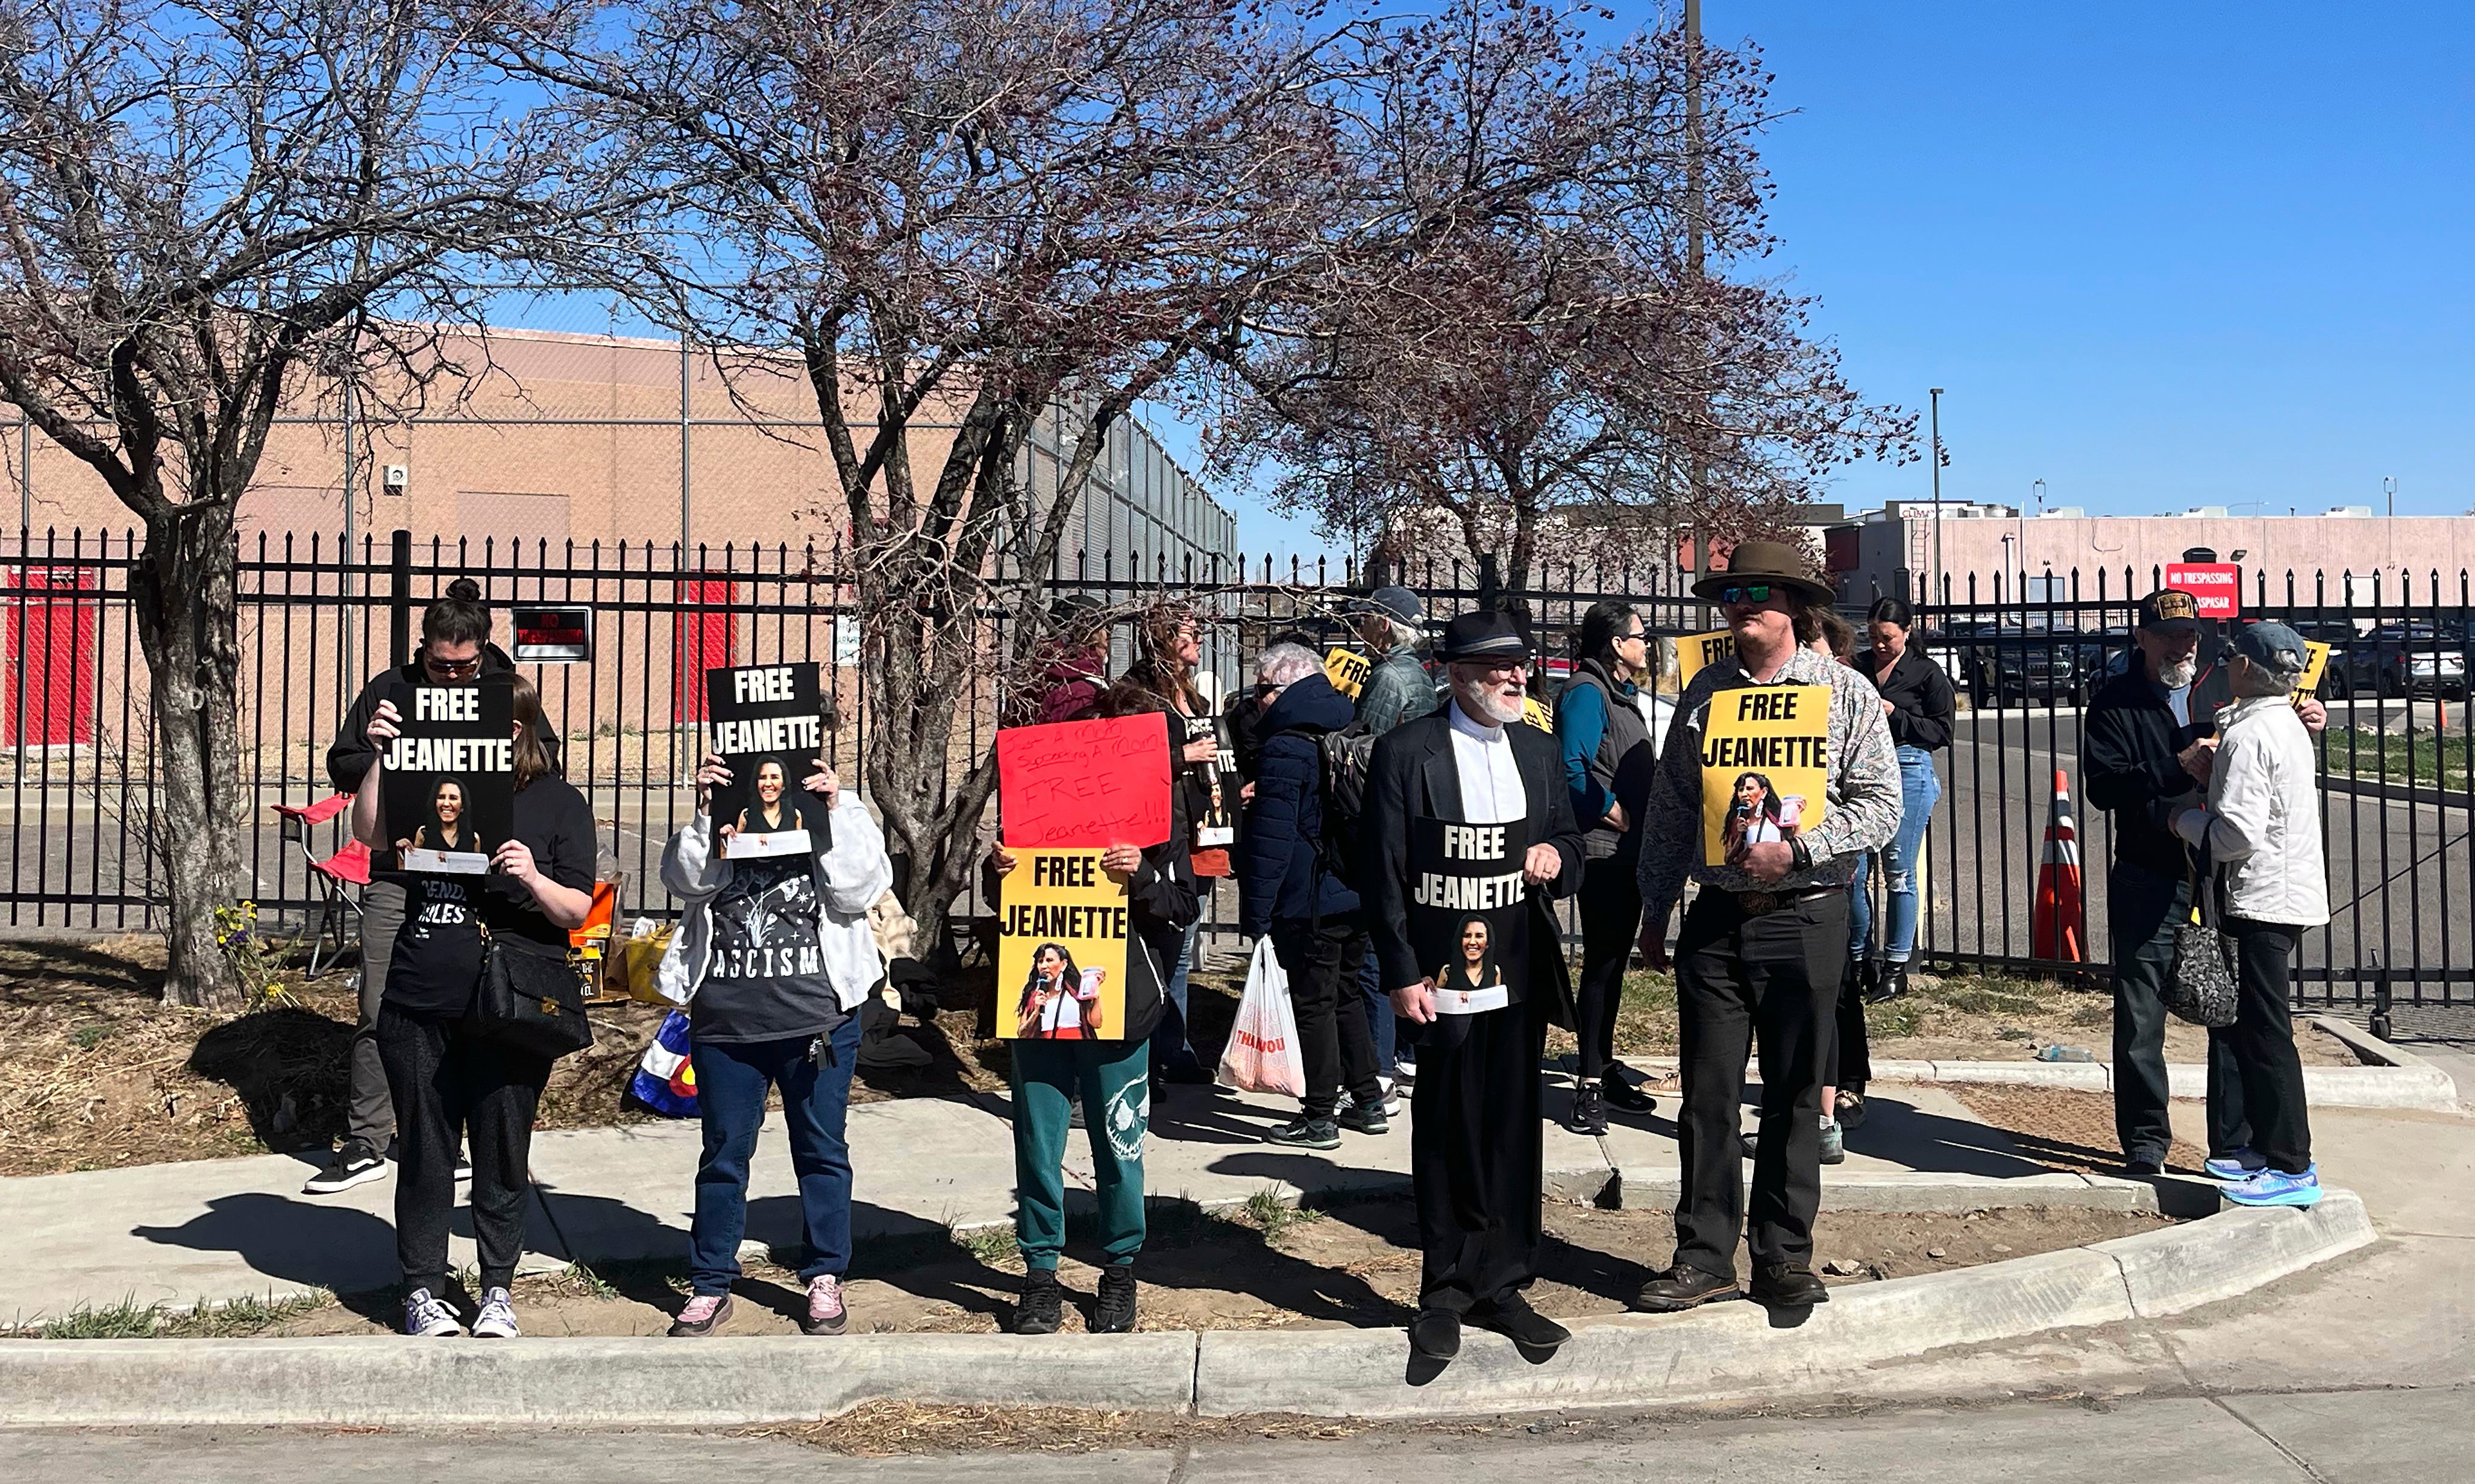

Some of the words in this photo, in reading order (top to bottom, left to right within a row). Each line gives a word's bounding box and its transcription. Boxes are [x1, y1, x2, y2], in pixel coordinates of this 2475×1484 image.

[2171, 572, 2182, 584] NO
[2183, 572, 2233, 584] TRESPASSING
[2197, 596, 2230, 609] ASPASAR
[1701, 636, 1736, 665] FRE
[735, 668, 794, 704] FREE
[1340, 658, 1372, 685] FRE
[416, 688, 479, 721] FREE
[1738, 693, 1798, 721] FREE
[712, 715, 820, 755] JEANETTE
[384, 737, 512, 772] JEANETTE
[1702, 736, 1827, 768] JEANETTE
[1020, 772, 1121, 809] FREE
[1018, 800, 1166, 847] Jeanette!!!
[1445, 825, 1505, 860] FREE
[1034, 856, 1096, 887] FREE
[1414, 869, 1525, 910] JEANETTE
[999, 905, 1126, 939] JEANETTE
[713, 945, 820, 978] ASCISM
